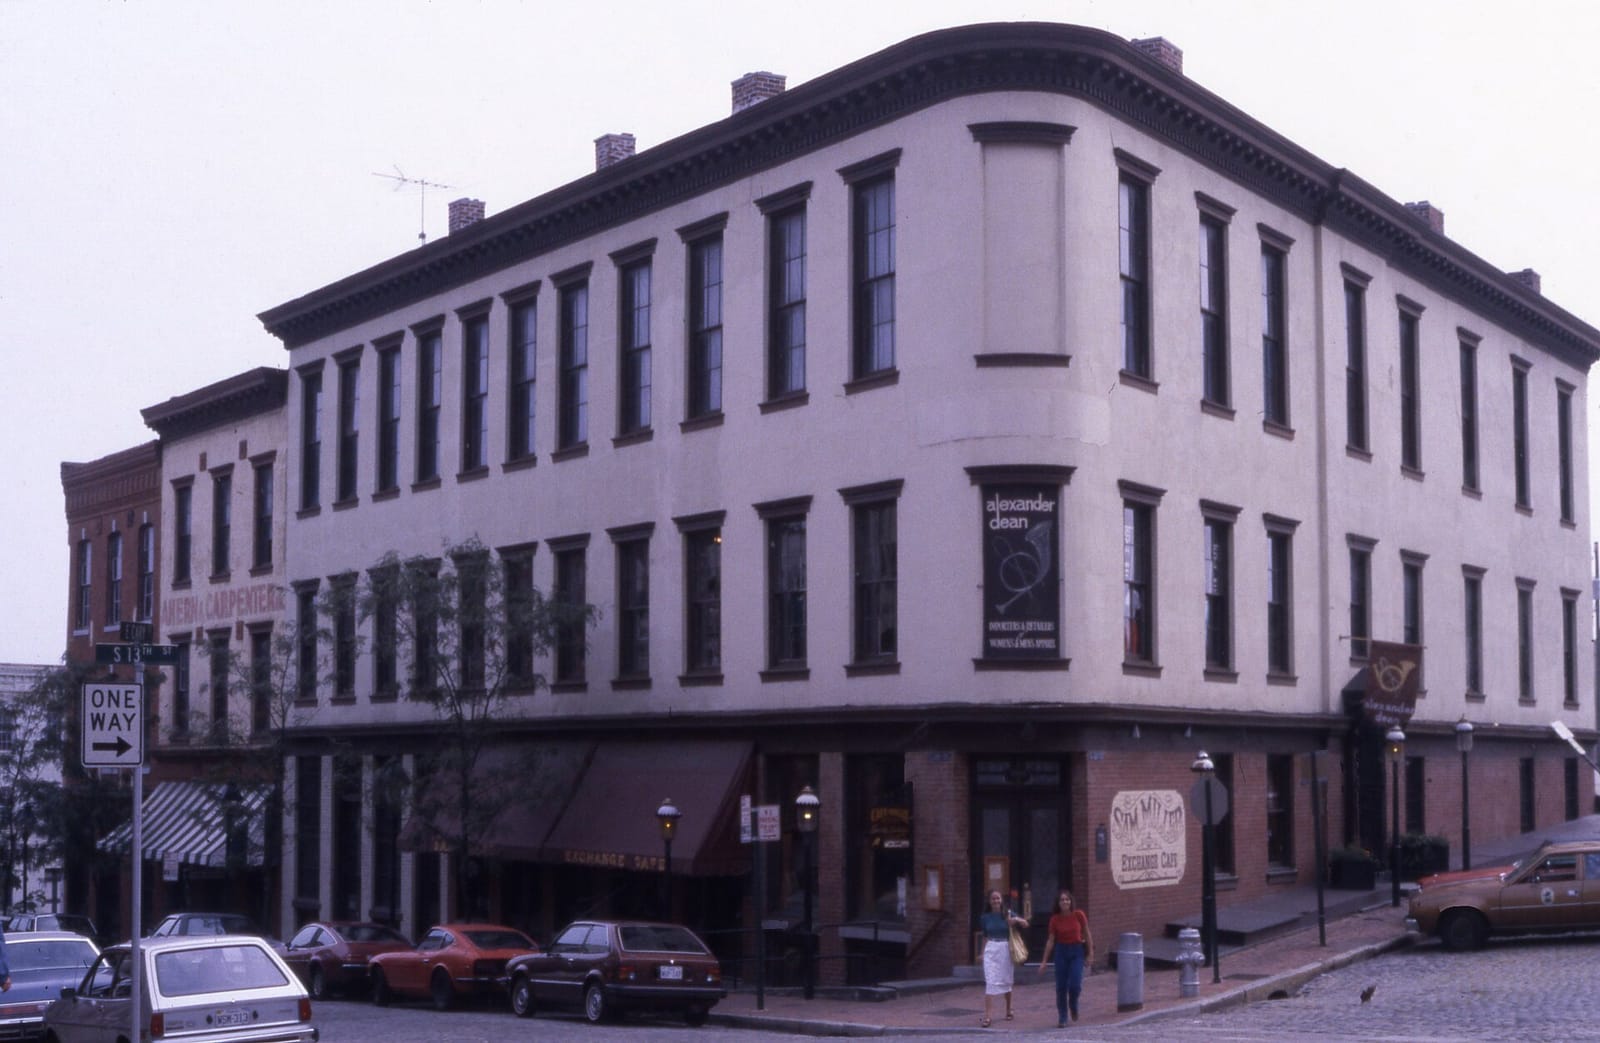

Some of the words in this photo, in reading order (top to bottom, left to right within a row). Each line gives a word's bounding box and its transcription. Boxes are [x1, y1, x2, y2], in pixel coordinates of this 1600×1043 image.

[986, 492, 1055, 512] alexander
[989, 511, 1028, 530] dean
[113, 646, 121, 663] S
[127, 646, 153, 663] 13TH
[161, 646, 172, 656] ST
[91, 689, 136, 709] ONE
[91, 712, 136, 732] WAY
[564, 850, 625, 868] EXCHANGE
[1121, 853, 1159, 872] EXCHANGE
